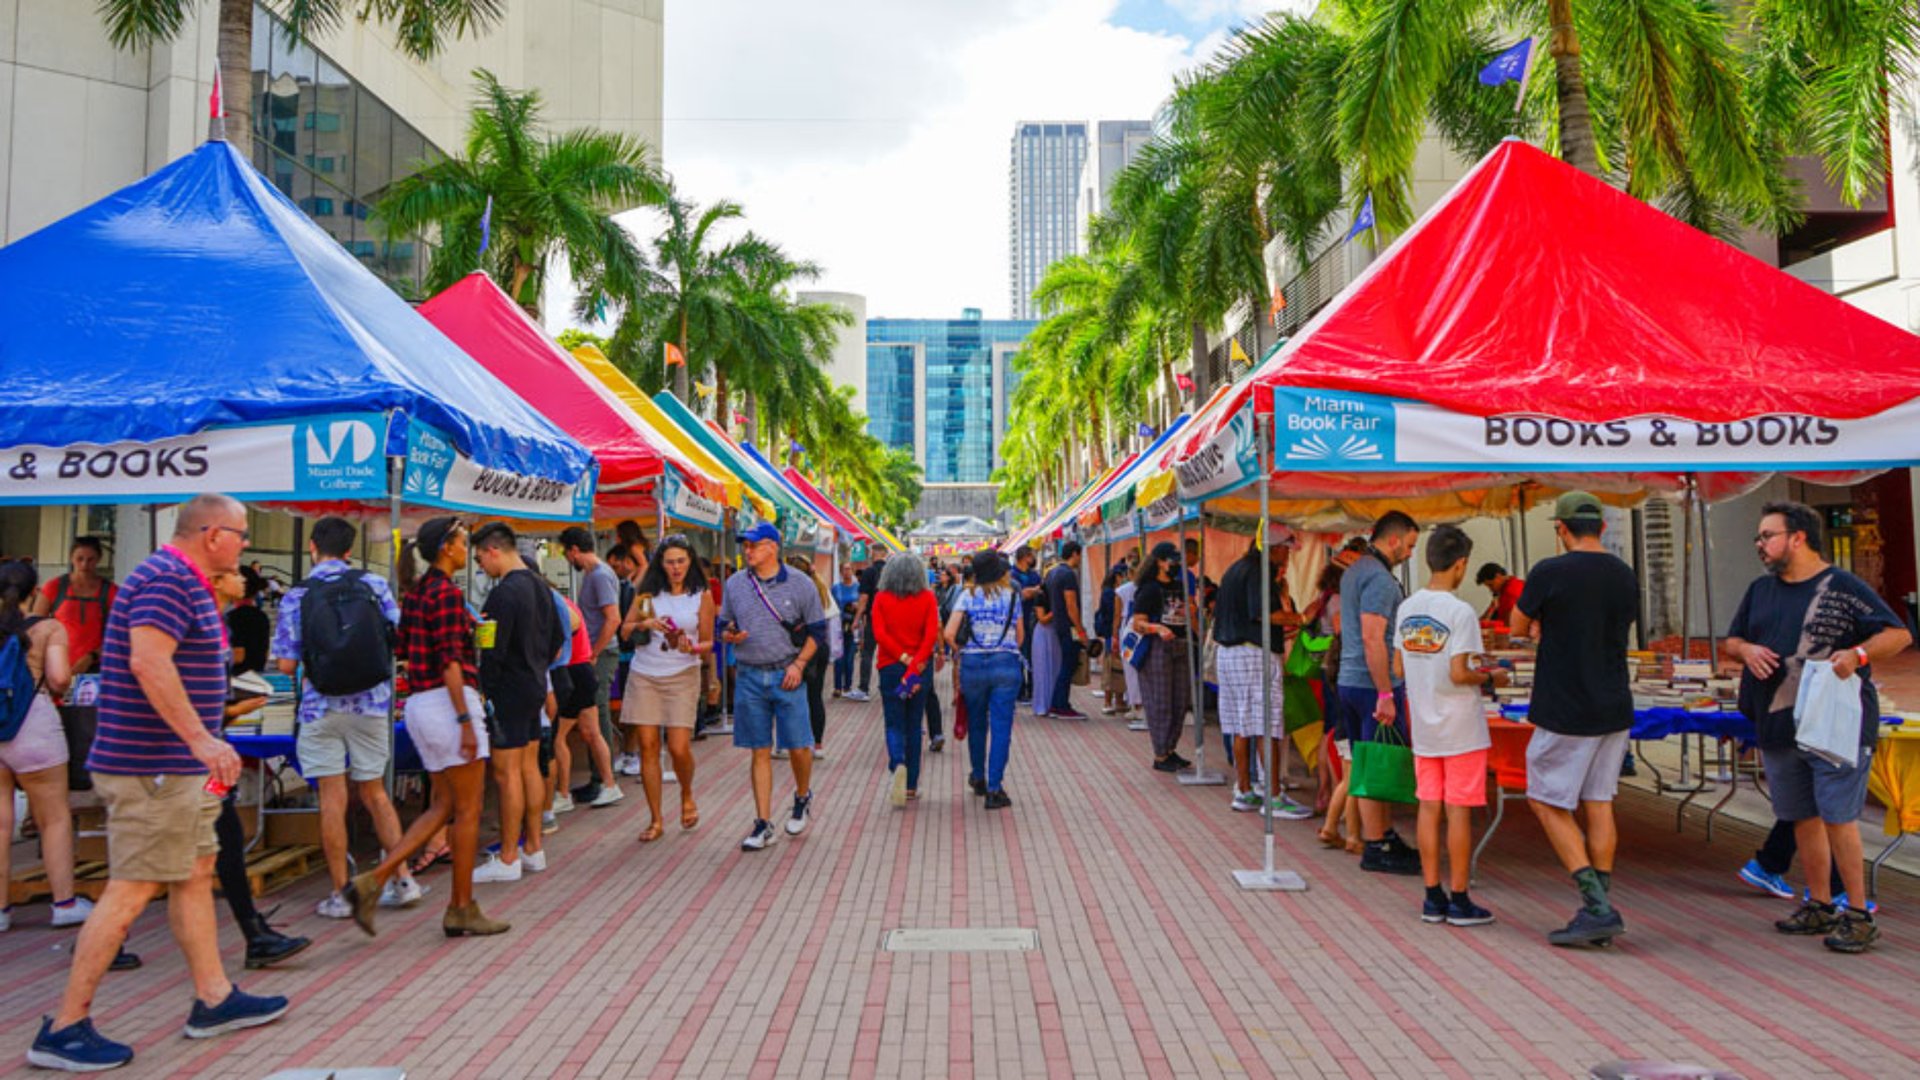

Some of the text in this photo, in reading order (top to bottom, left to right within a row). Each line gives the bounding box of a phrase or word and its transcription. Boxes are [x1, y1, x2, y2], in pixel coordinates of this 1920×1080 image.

[1304, 396, 1364, 412] Miami
[1288, 413, 1381, 430] Book Fair
[1485, 415, 1839, 447] BOOKS & BOOKS
[9, 445, 209, 480] & BOOKS
[411, 446, 430, 466] Book
[308, 465, 375, 477] Miami Dade
[320, 479, 363, 491] College
[473, 467, 522, 497] BOOKS
